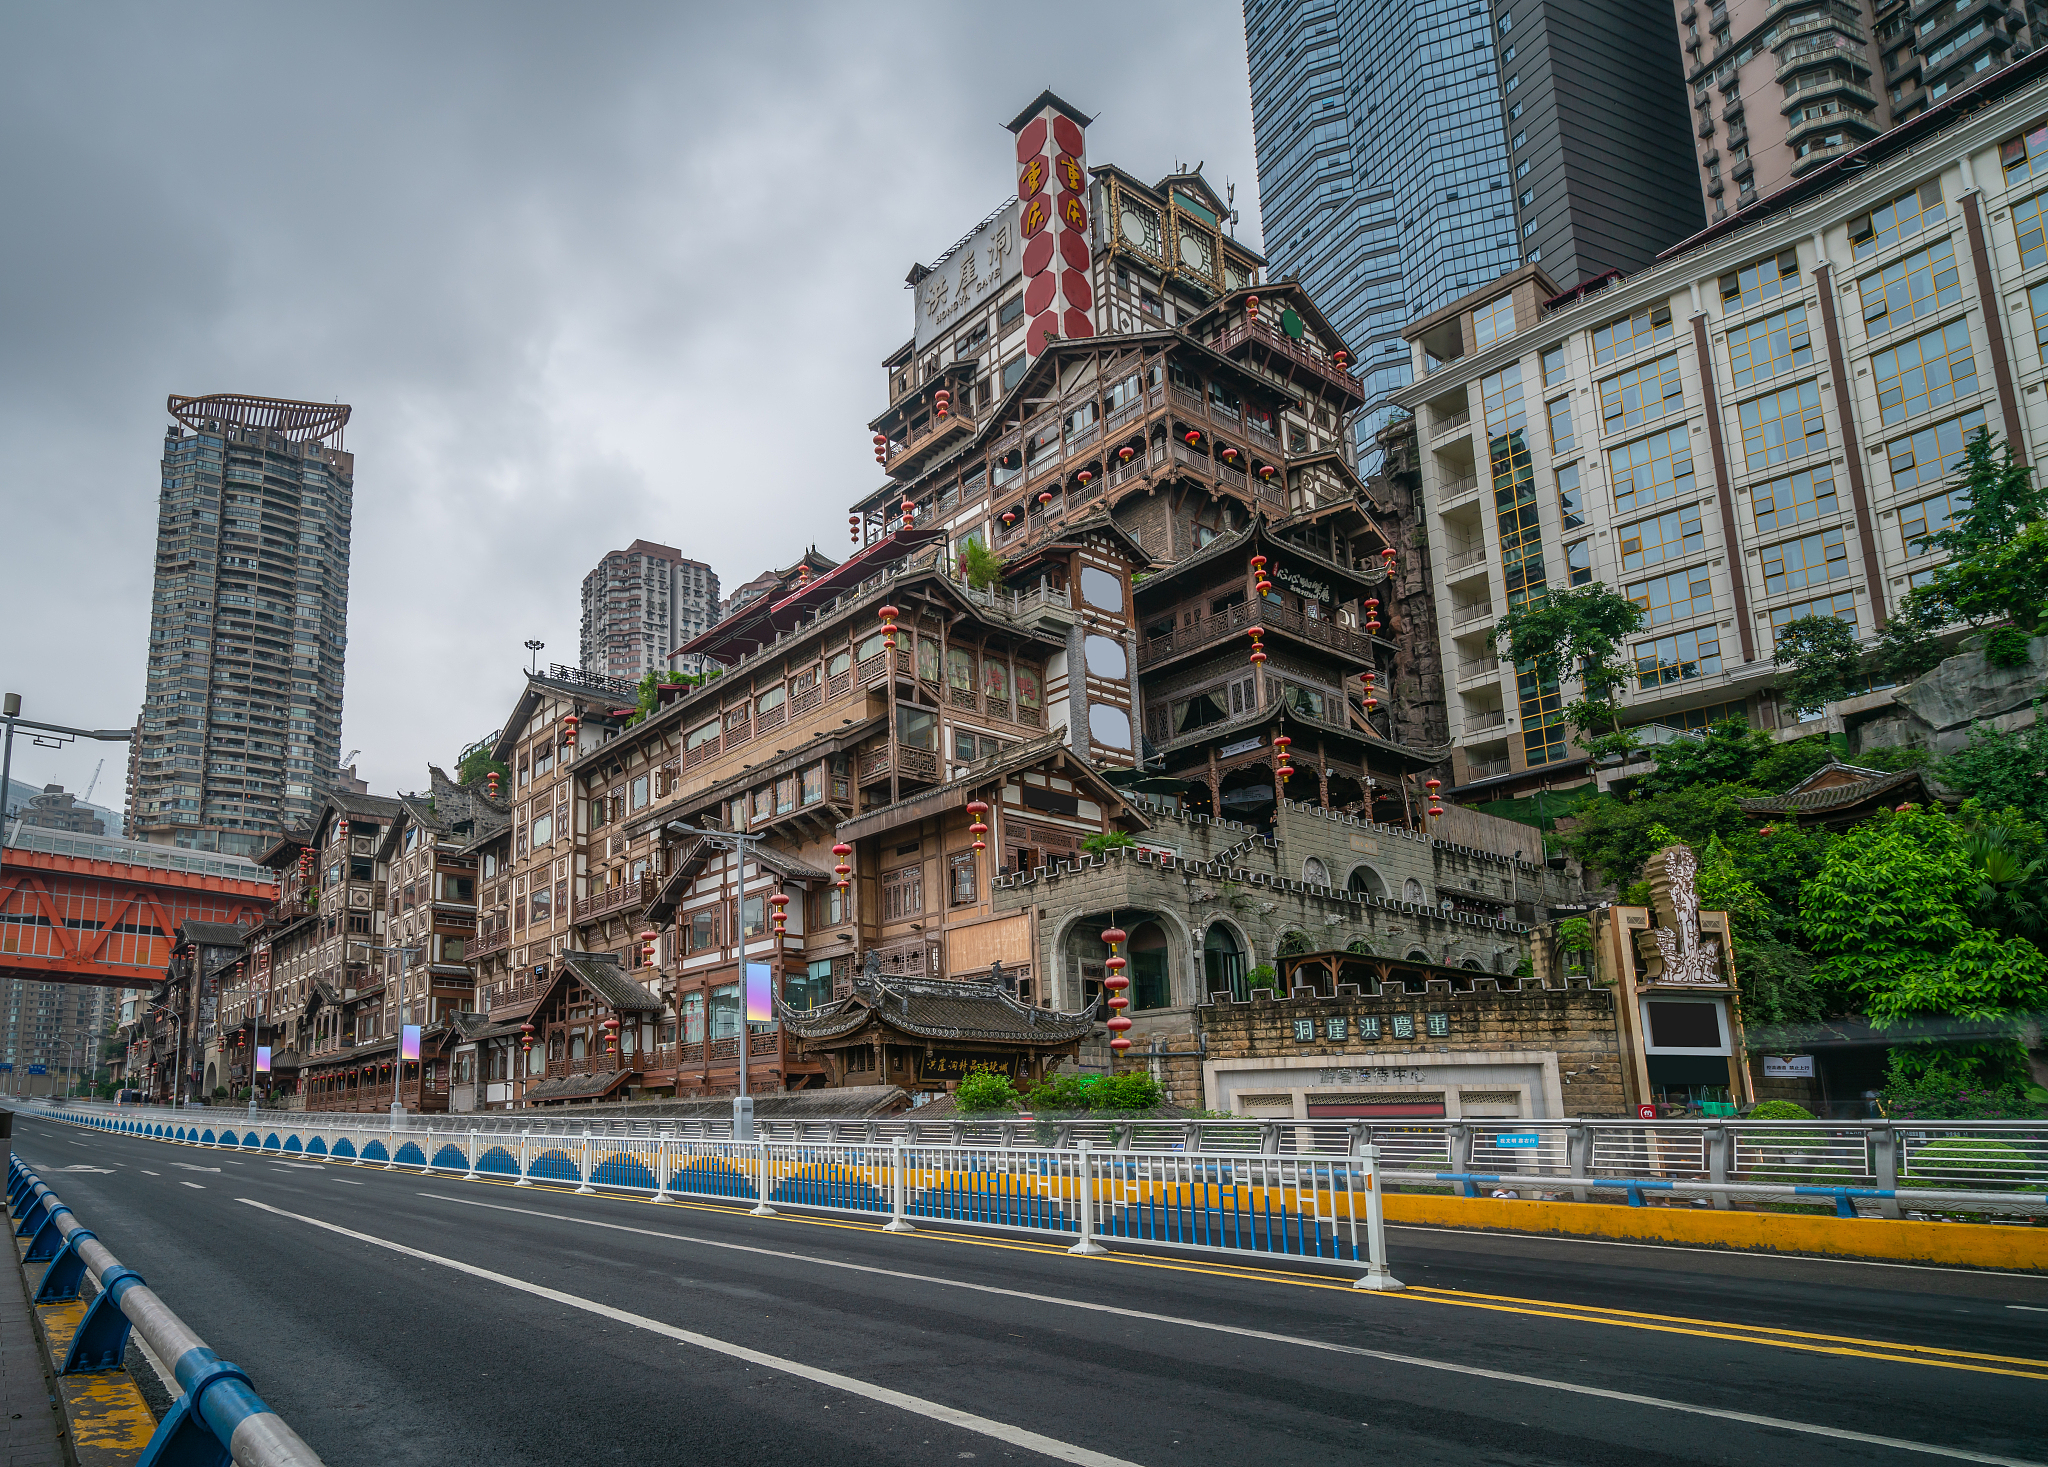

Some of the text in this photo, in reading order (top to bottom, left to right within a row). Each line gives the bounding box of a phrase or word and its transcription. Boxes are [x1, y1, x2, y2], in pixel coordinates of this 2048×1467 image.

[924, 221, 1012, 316] 洪崖洞
[935, 267, 1001, 325] HONGYA CAVE
[985, 667, 1036, 701] 烤鸭
[1319, 1067, 1426, 1083] 游客接待中心
